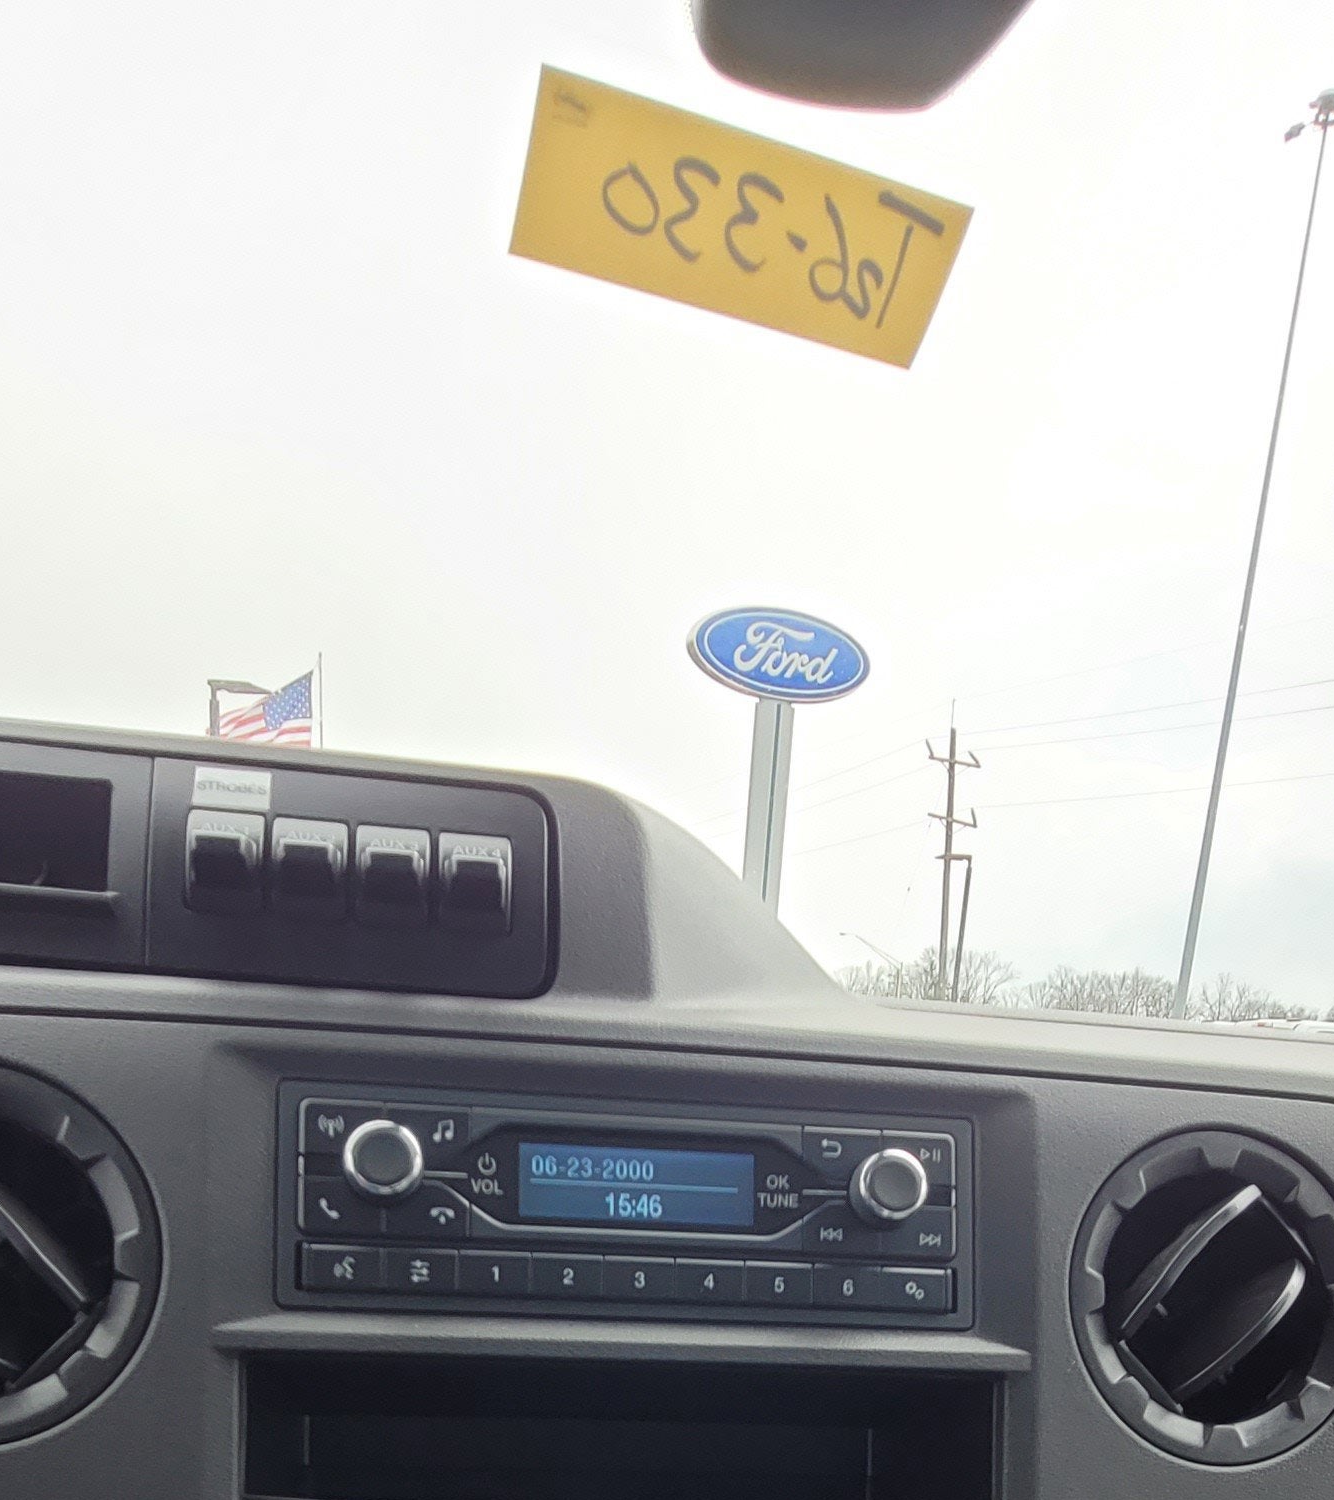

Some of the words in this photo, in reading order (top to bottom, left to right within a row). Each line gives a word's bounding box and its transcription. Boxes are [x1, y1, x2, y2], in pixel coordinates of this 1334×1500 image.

[733, 621, 839, 685] Ford
[196, 779, 268, 796] STROBES
[531, 1154, 655, 1181] 06-23-2000
[471, 1178, 504, 1196] VOL
[766, 1173, 790, 1190] OK
[605, 1191, 664, 1218] 15:46
[756, 1191, 800, 1209] TUNE
[491, 1264, 501, 1284] 1
[562, 1266, 575, 1286] 2
[633, 1270, 647, 1290] 3
[703, 1272, 716, 1291] 4
[773, 1276, 786, 1294] 5
[842, 1278, 855, 1297] 6
